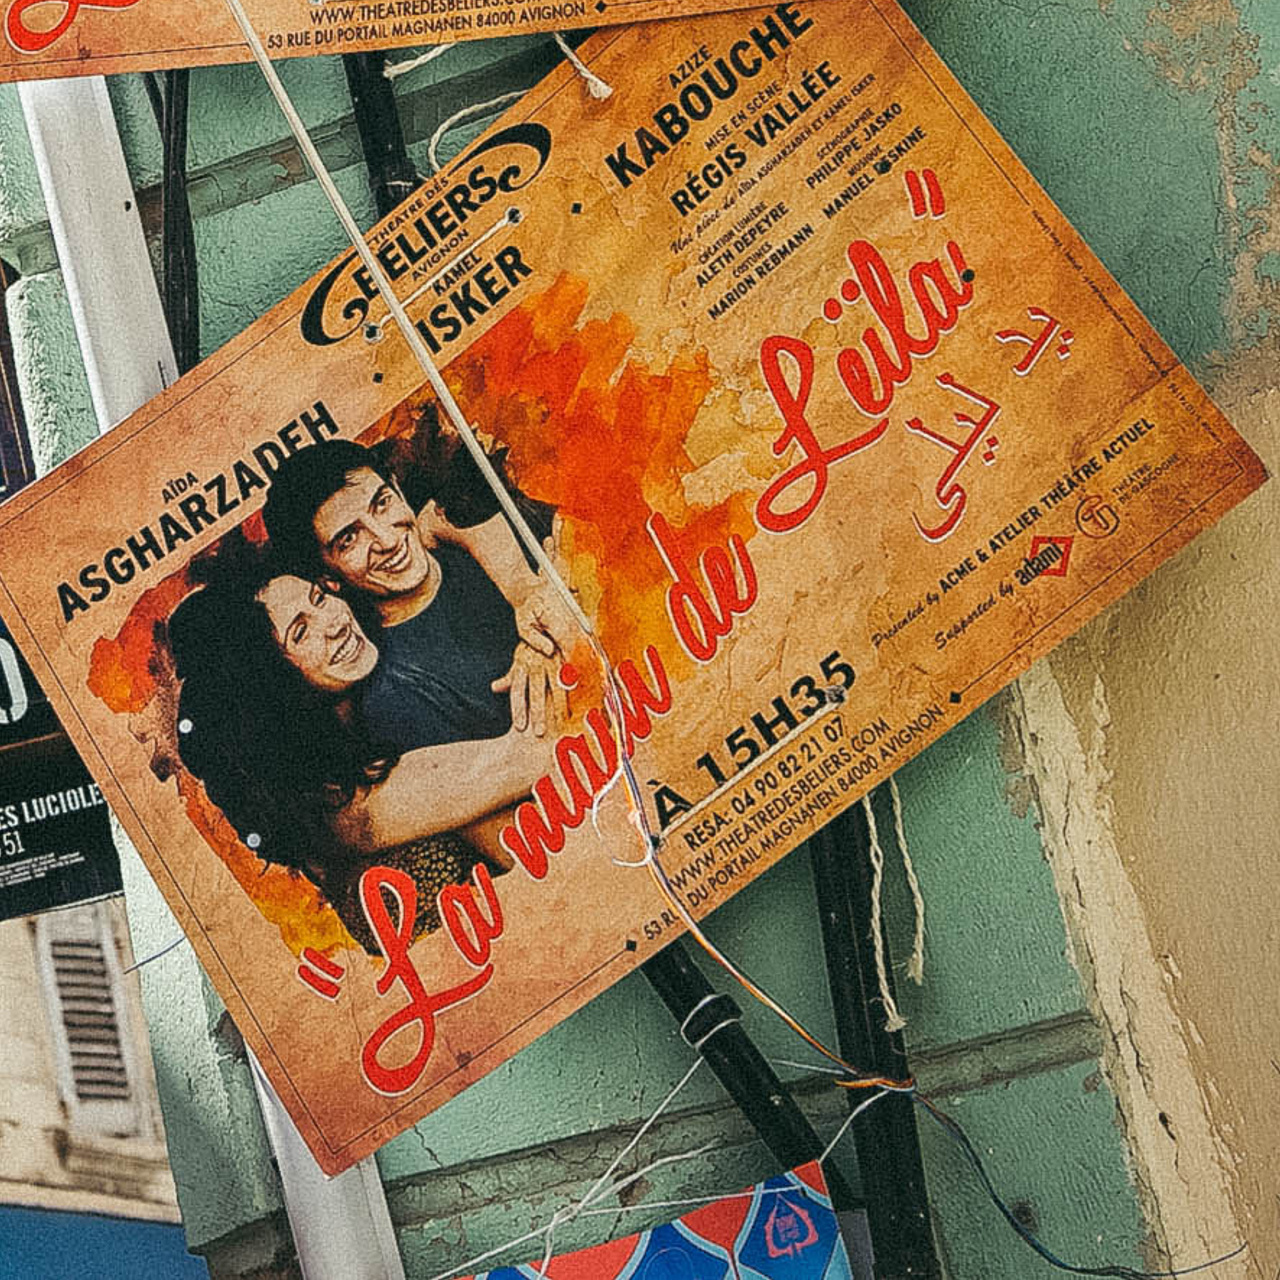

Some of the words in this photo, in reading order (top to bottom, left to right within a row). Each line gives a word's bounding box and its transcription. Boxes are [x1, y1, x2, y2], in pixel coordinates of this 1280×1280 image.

[267, 34, 284, 49] 53
[287, 32, 312, 48] RUE
[314, 29, 334, 45] DU
[337, 24, 387, 43] PORTAIL
[391, 16, 472, 37] MAGNANEN
[476, 11, 516, 28] 84000
[519, 2, 586, 24] AVIGNON
[669, 44, 713, 90] AZIZE
[604, 2, 815, 190] KABOUCHE
[669, 142, 748, 218] RÉGIS
[744, 61, 842, 148] VALLÉE
[704, 124, 733, 152] MISE
[730, 110, 748, 129] EN
[805, 136, 862, 190] PHILIPPE
[862, 102, 902, 142] JASKO
[822, 173, 876, 220] MANUEL
[411, 228, 469, 282] AVIGNON
[432, 250, 483, 297] KAMEL
[696, 249, 736, 289] ALETH
[732, 201, 790, 254] DEPEYRE
[707, 274, 757, 320] MARION
[754, 223, 815, 279] REBMANN
[415, 245, 534, 355] ISKER
[56, 400, 340, 624] ASGHARZADEH
[161, 471, 199, 505] AÏDA
[938, 556, 977, 595] ACME
[977, 547, 990, 563] &
[988, 505, 1044, 556] ATELIER
[1039, 458, 1103, 511] THÉÂTRE
[1101, 417, 1156, 464] ACTUEL
[646, 513, 759, 667] de
[934, 592, 998, 651] Supported
[998, 578, 1014, 600] by
[647, 778, 696, 831] À
[696, 650, 857, 788] 15H35
[683, 810, 733, 853] RESA:
[731, 787, 757, 815] 04
[754, 771, 780, 798] 90
[777, 753, 802, 780] 82
[800, 734, 824, 764] 21
[824, 716, 847, 744] 07
[4, 830, 26, 855] 51
[643, 920, 662, 940] 53
[686, 884, 709, 907] DU
[708, 846, 762, 892] PORTAIL
[759, 785, 838, 853] MAGNANEN
[838, 755, 879, 796] 84000
[880, 703, 945, 762] AVIGNON
[669, 718, 891, 892] WWW.THEATREDESBELIERS.COM
